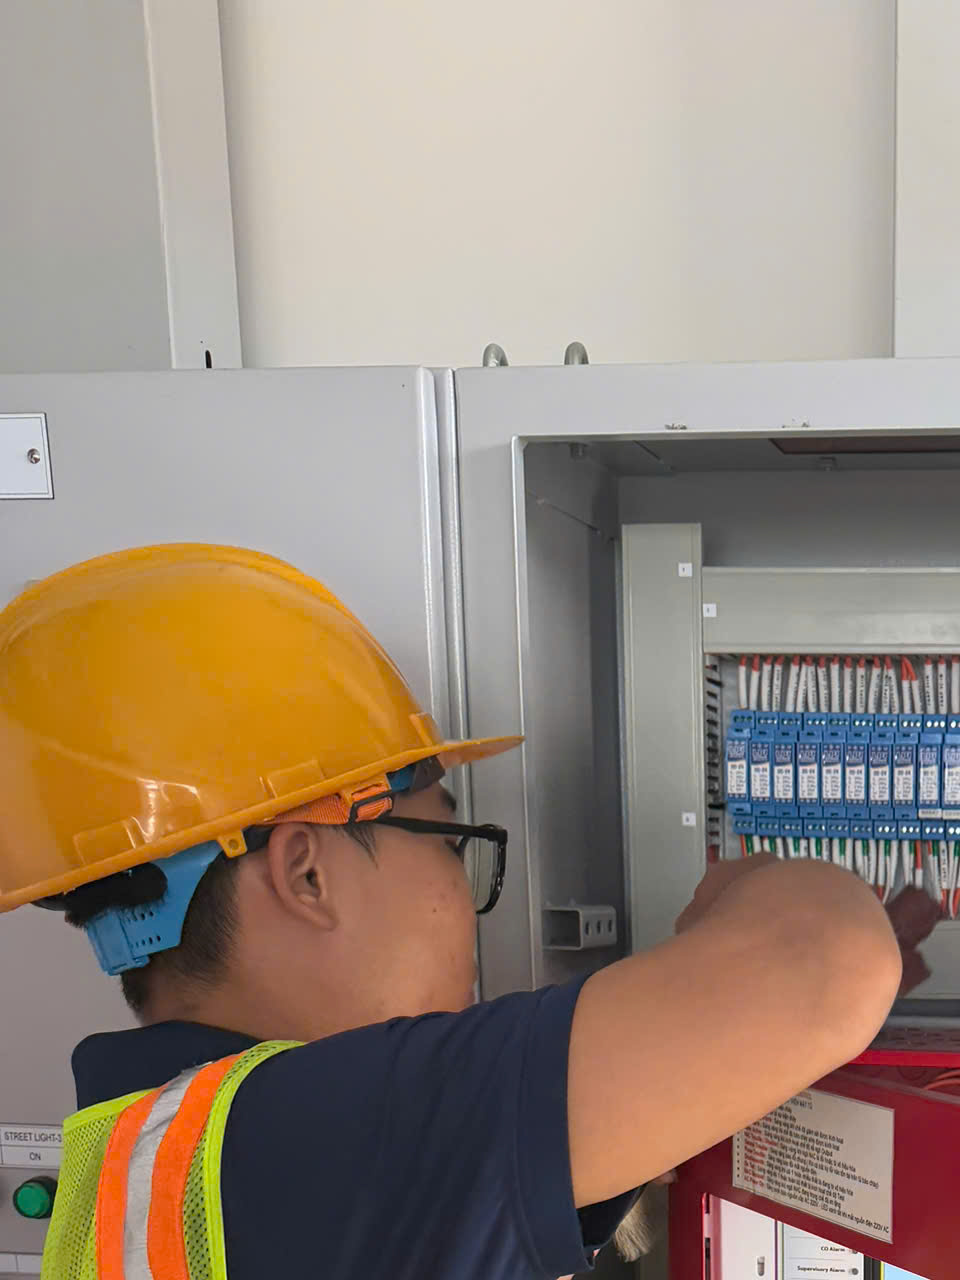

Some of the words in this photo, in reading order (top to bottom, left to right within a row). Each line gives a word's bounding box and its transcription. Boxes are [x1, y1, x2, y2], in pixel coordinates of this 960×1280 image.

[4, 1131, 33, 1142] STREET
[29, 1151, 41, 1161] ON
[797, 1265, 829, 1273] Supervisory
